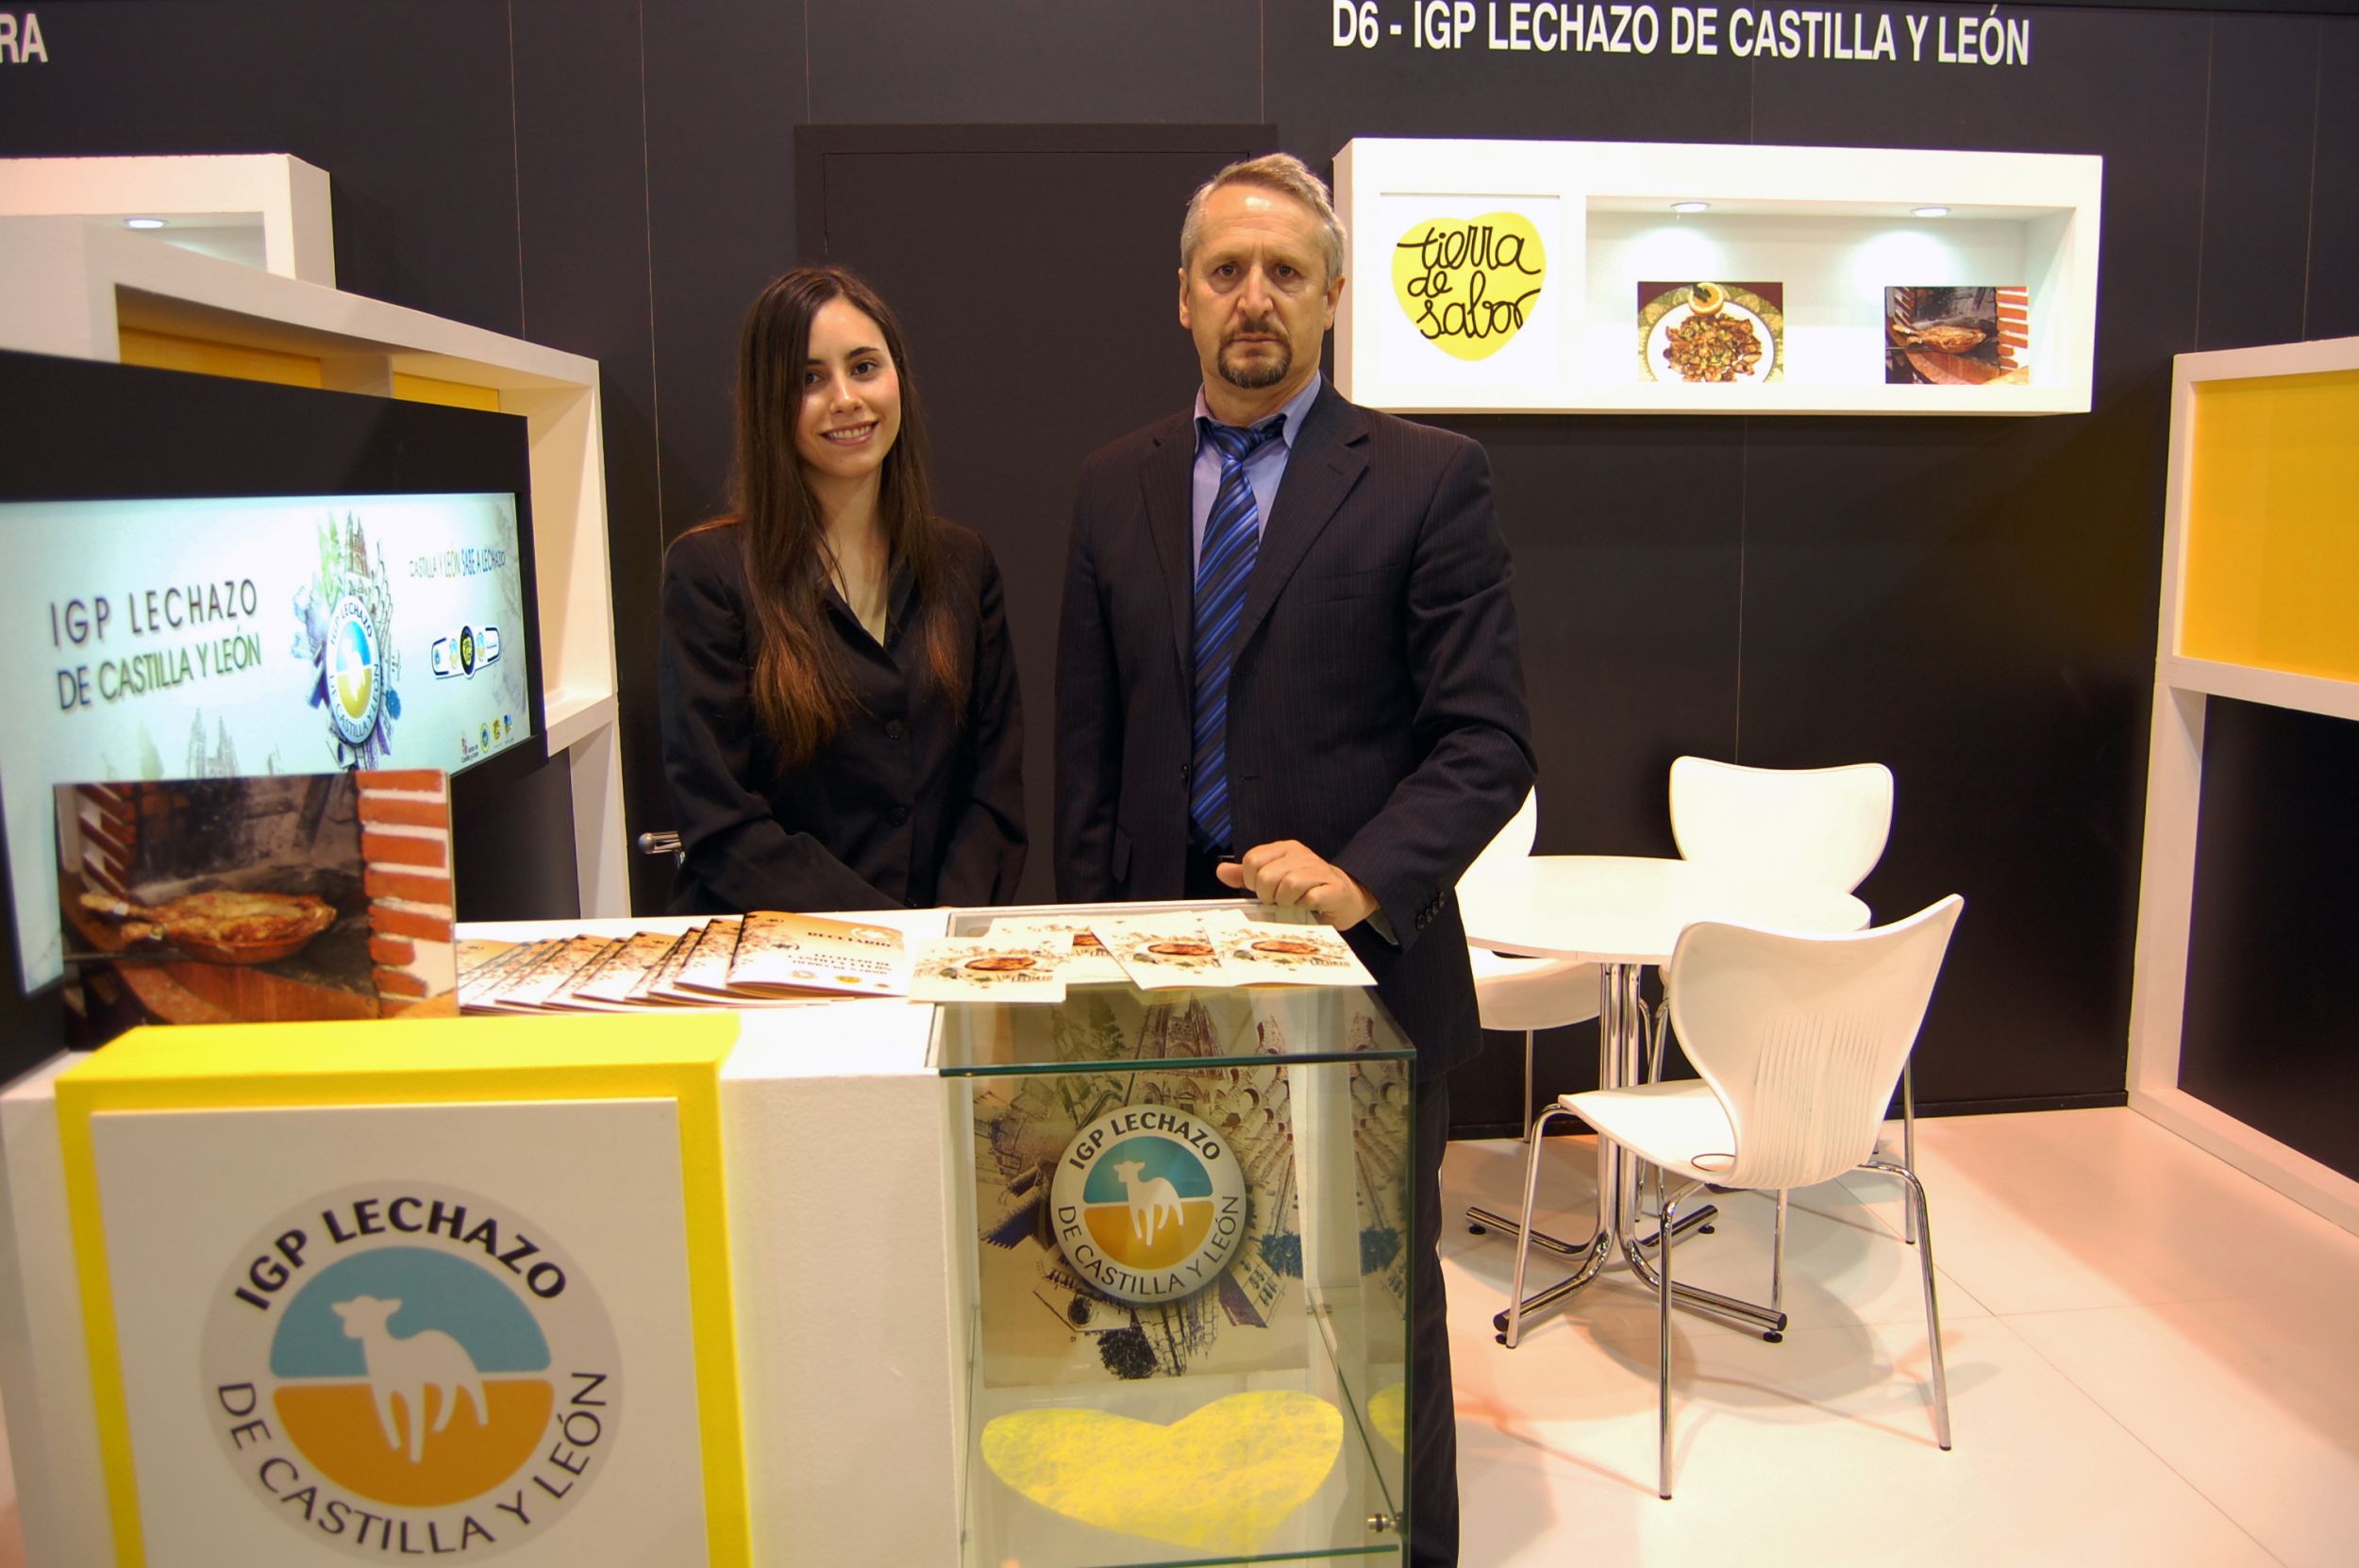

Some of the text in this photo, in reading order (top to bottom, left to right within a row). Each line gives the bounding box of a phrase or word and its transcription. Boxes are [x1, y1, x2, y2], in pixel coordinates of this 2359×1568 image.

[1332, 0, 2030, 66] D6 - IGP LECHAZO DE CASTILLA Y LEÓN
[1397, 225, 1542, 275] tierra
[1407, 269, 1453, 299] de
[1416, 270, 1542, 340] sabor
[50, 578, 258, 647] IGP LECHAZO
[341, 601, 373, 639] LECHAZO
[57, 626, 261, 710] DE CASTILLA Y LEÓN
[335, 703, 368, 739] CASTILLA
[1069, 1111, 1221, 1170] IGP LECHAZO
[234, 1196, 566, 1311] IGP LECHAZO
[1058, 1195, 1239, 1295] DE CASTILLA Y LEÓN
[217, 1371, 608, 1555] DE CASTILLA Y LEÓN
